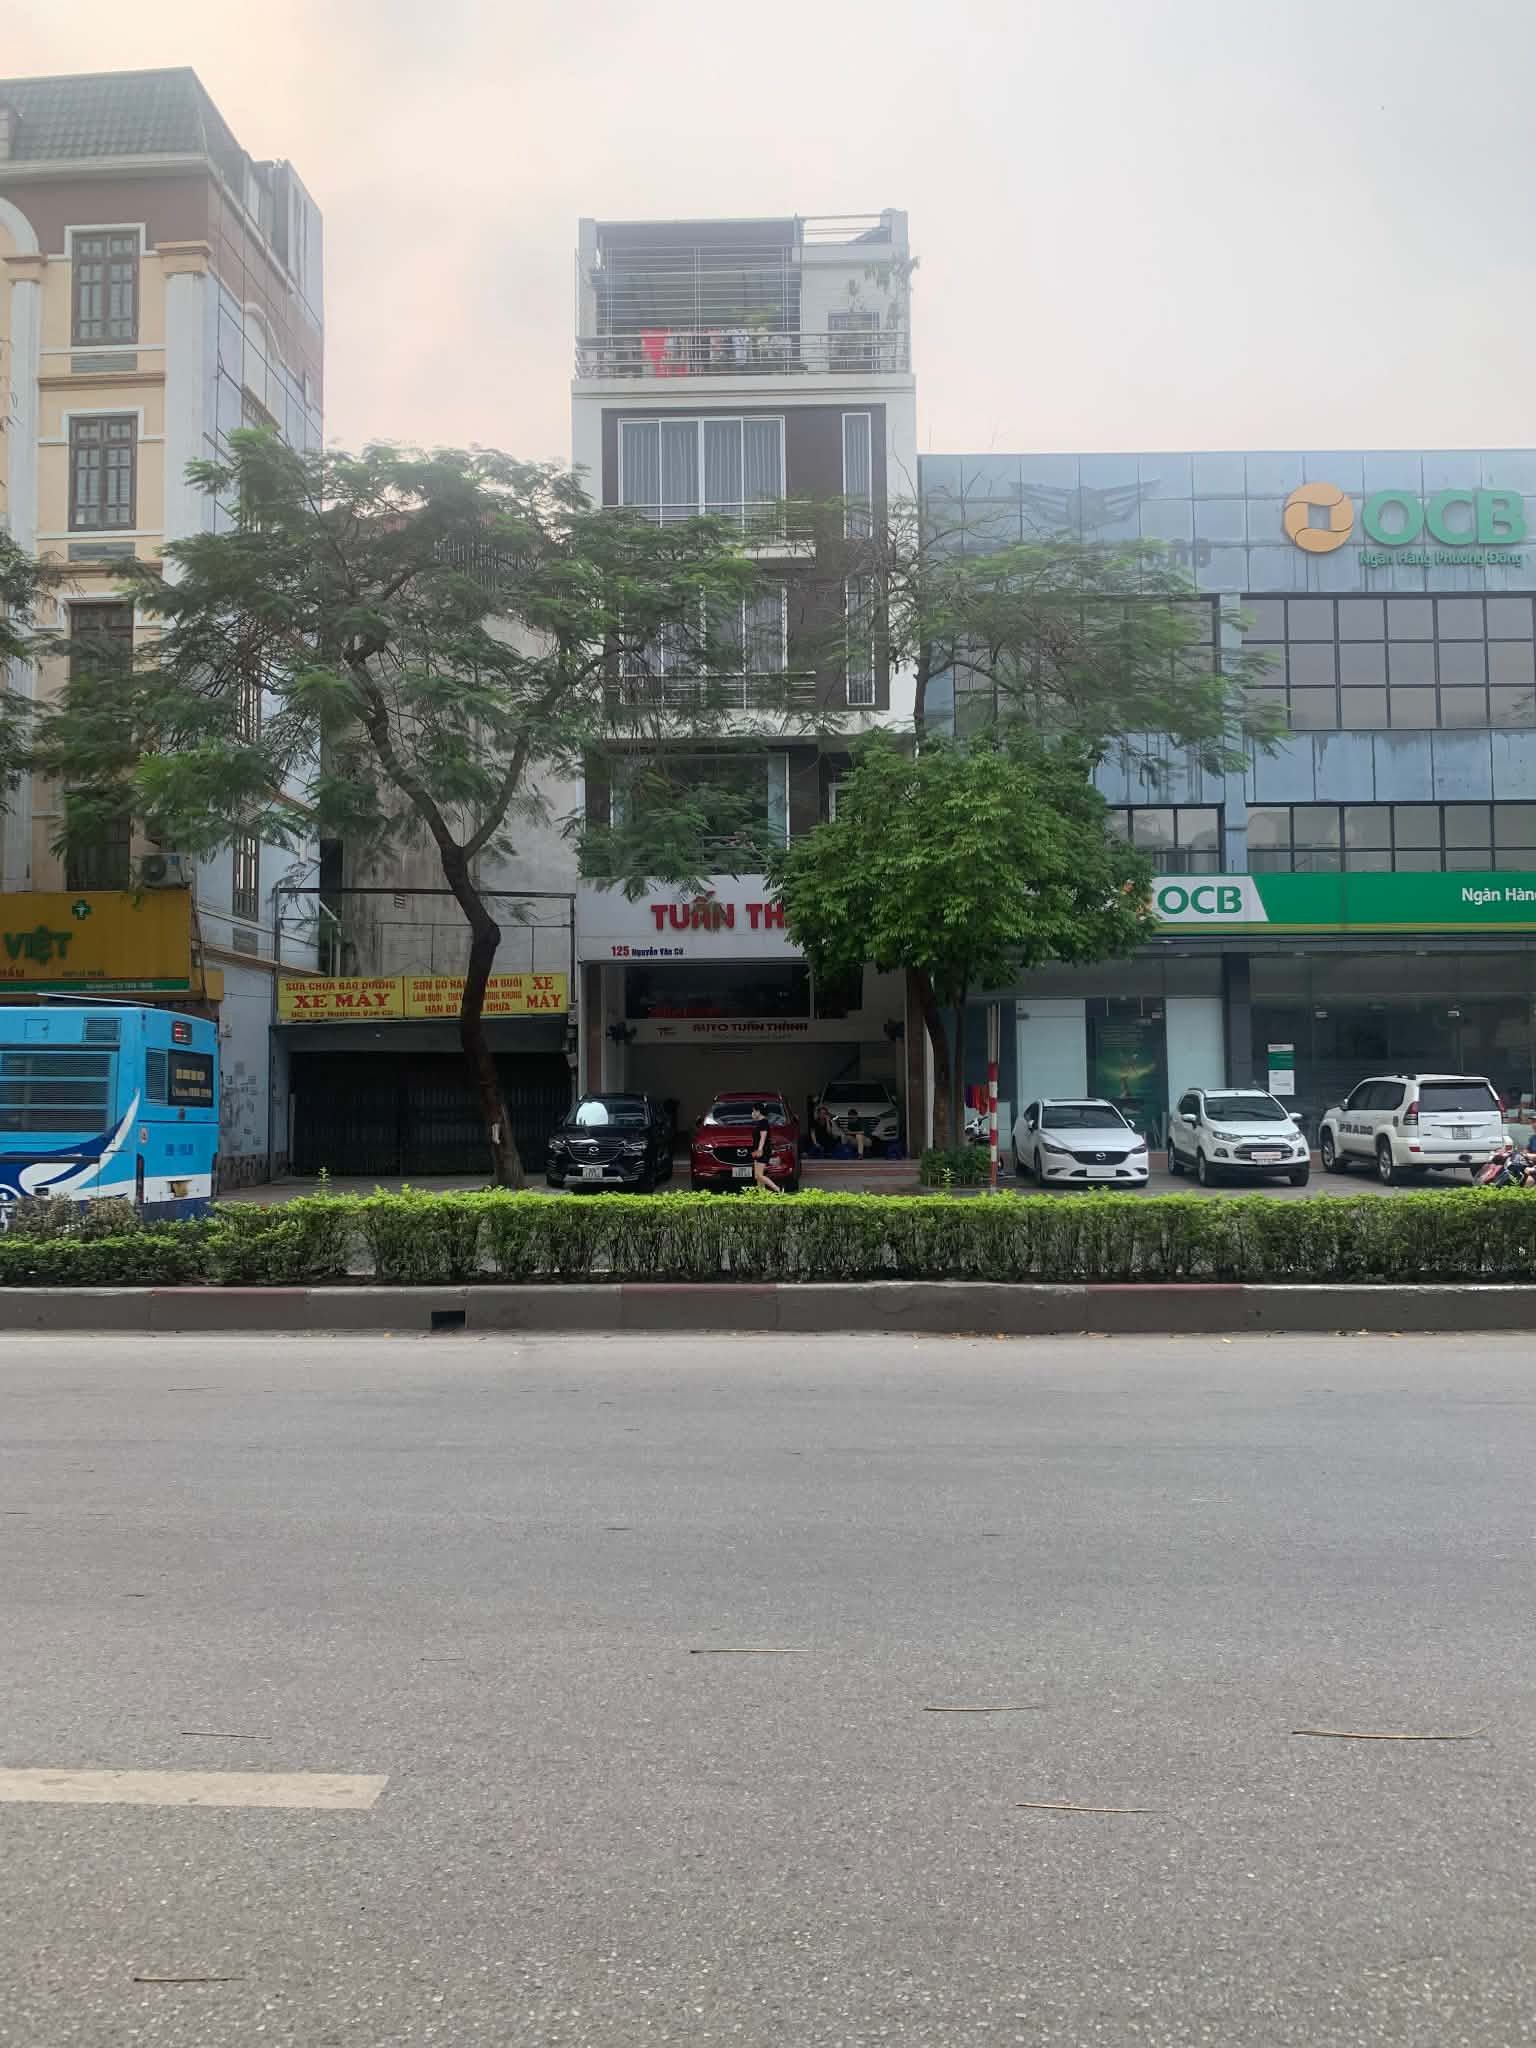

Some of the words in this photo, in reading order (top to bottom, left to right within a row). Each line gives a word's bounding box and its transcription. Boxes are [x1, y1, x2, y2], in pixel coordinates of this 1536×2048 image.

[1363, 489, 1527, 545] OCB
[1360, 551, 1393, 568] Ngân
[1158, 886, 1242, 914] OCB
[1462, 887, 1501, 905] Ngân
[746, 904, 792, 929] TH
[611, 946, 629, 956] 125
[532, 976, 553, 990] XE
[294, 994, 328, 1008] XE
[335, 991, 391, 1008] MÁY
[526, 992, 561, 1008] MÁY
[1338, 1123, 1374, 1135] PRADO
